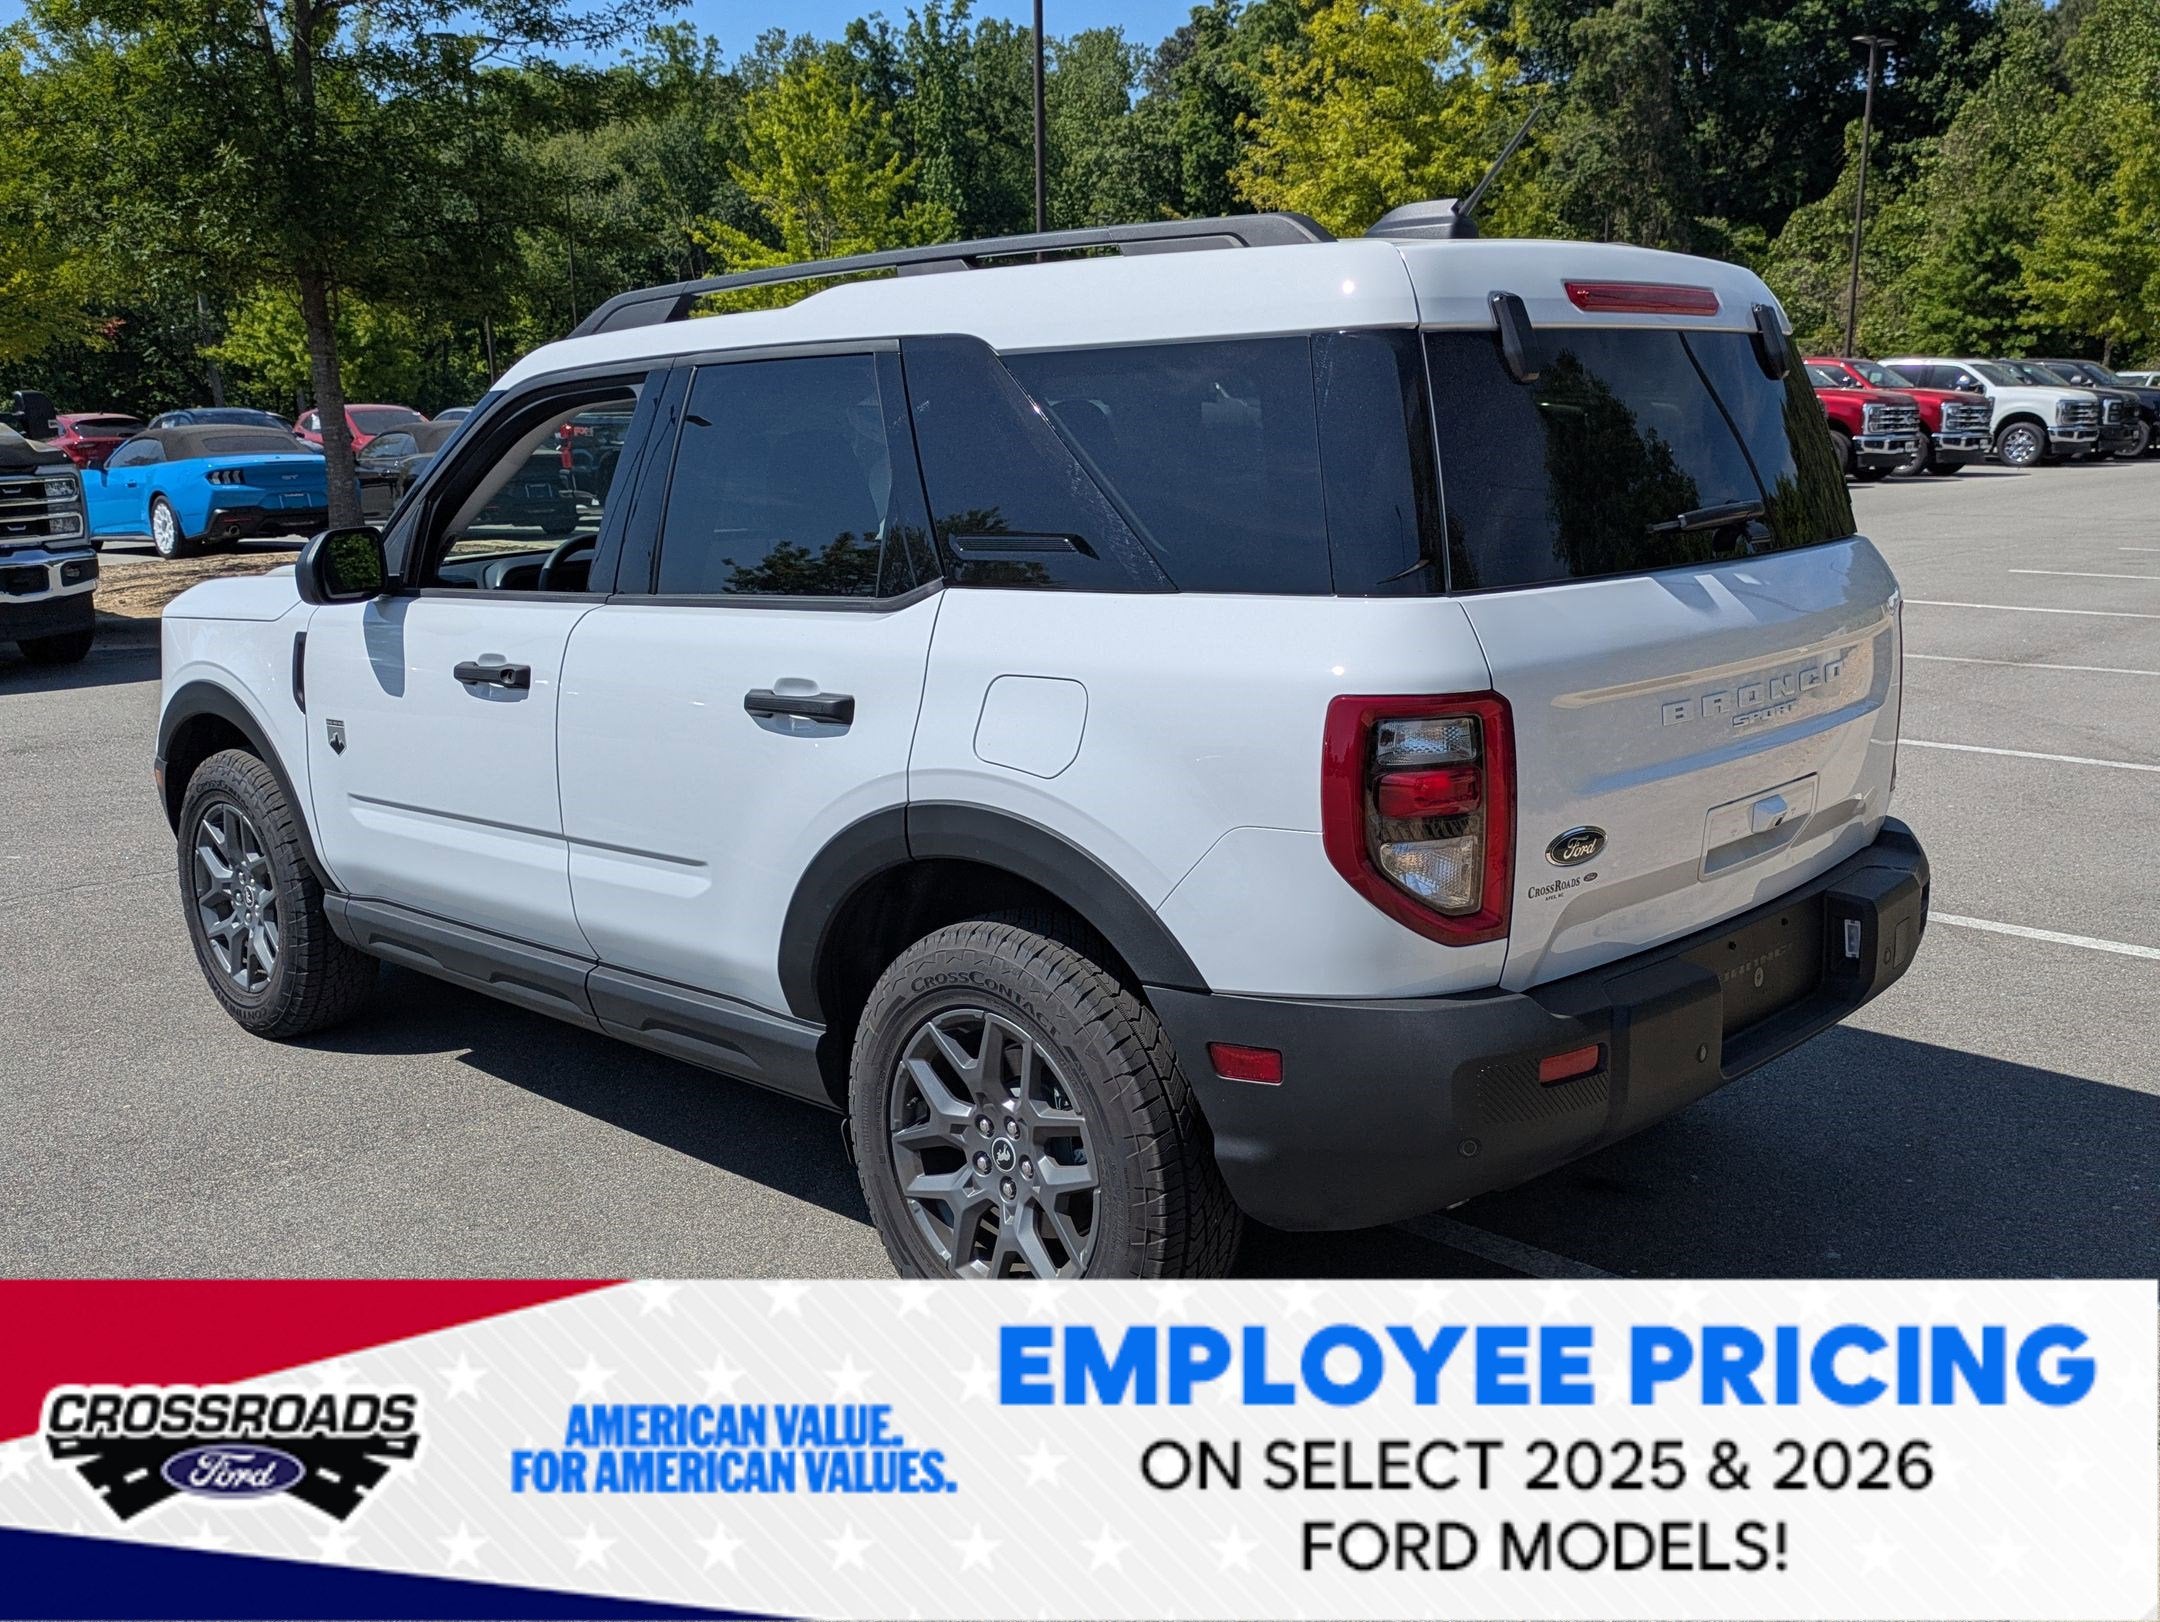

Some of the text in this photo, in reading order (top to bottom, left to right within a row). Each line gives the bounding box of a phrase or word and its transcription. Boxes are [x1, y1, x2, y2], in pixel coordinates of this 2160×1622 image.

[1661, 658, 1846, 727] BRONCO
[1732, 698, 1797, 728] SPORT
[1563, 835, 1597, 860] Ford
